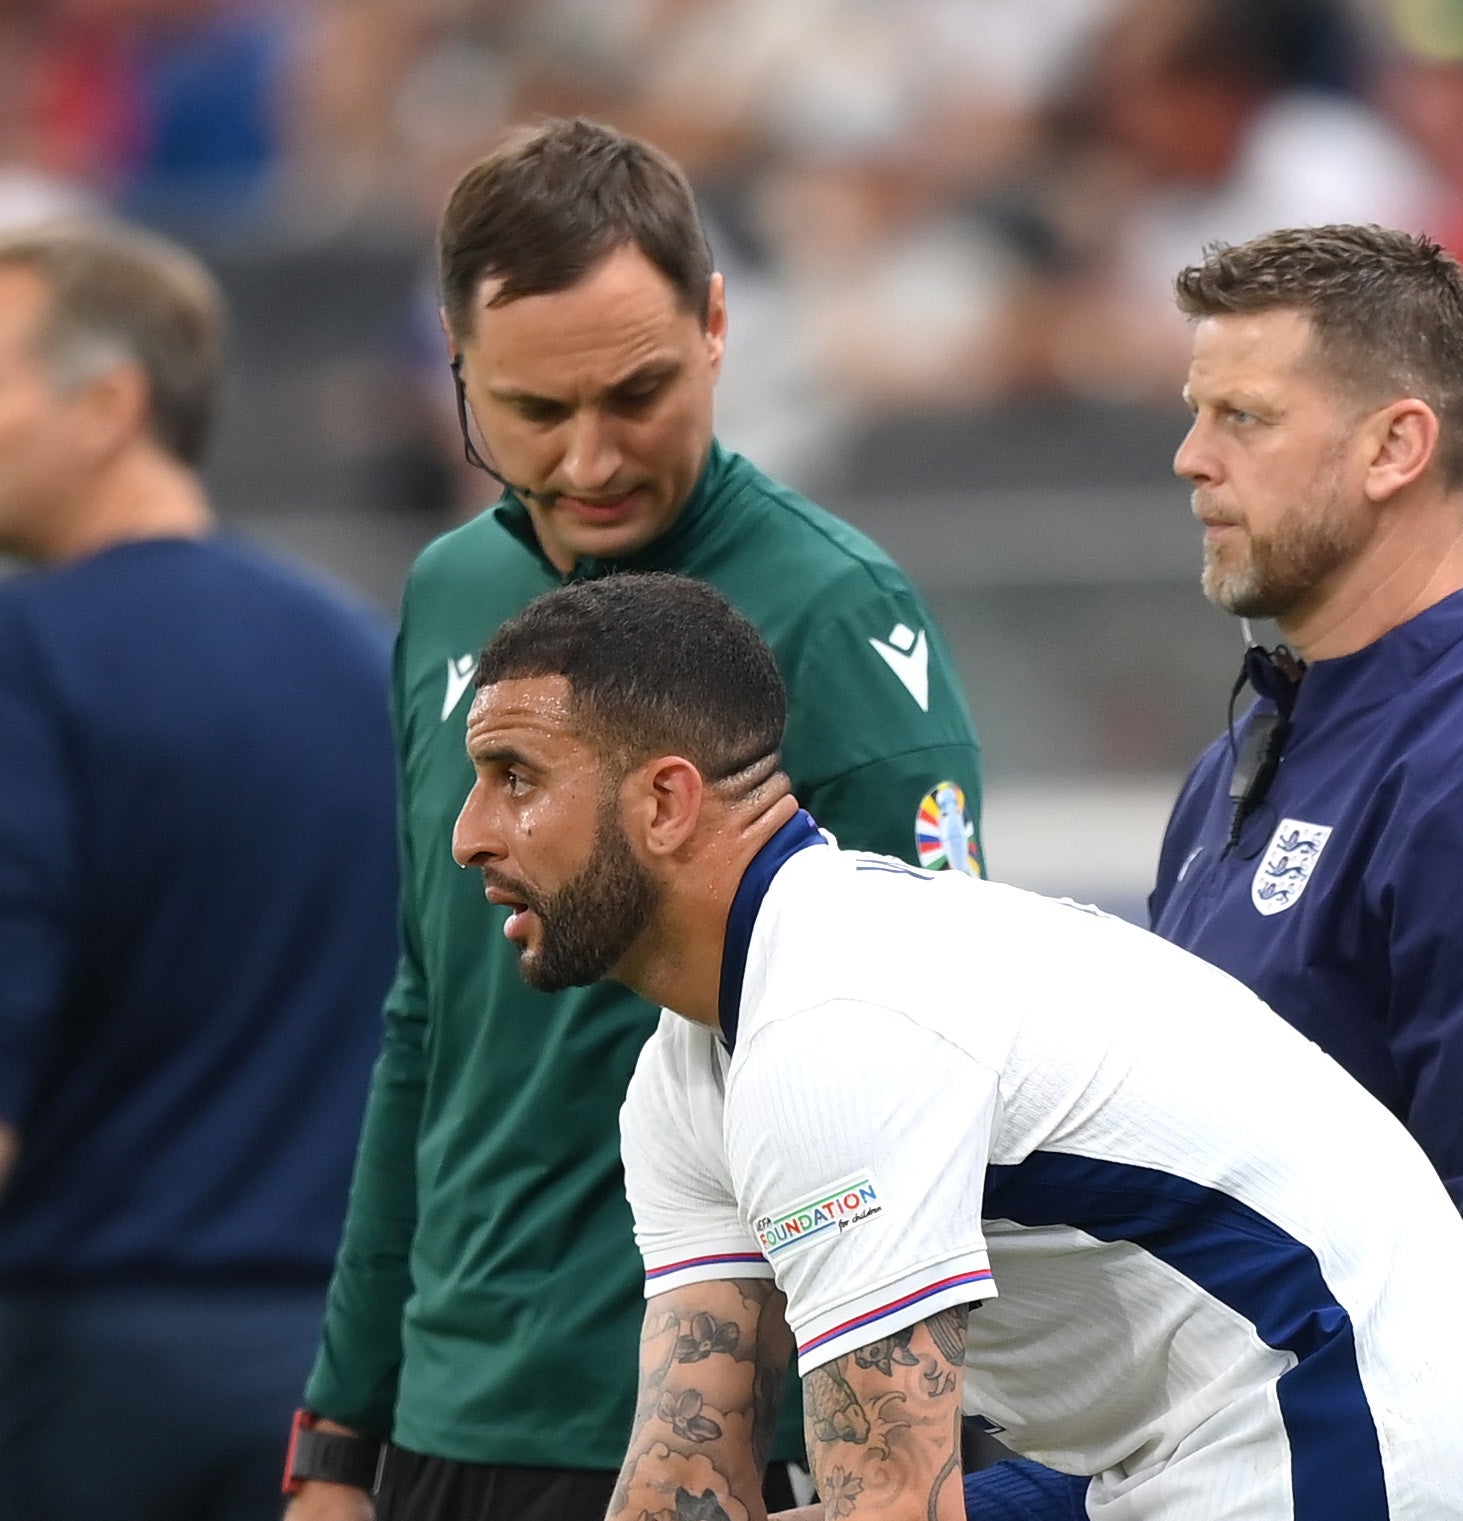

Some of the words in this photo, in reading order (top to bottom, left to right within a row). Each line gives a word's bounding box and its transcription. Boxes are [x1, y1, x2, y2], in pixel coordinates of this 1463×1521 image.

[759, 1185, 877, 1248] FOUNDATION
[838, 1218, 849, 1233] for
[852, 1206, 881, 1223] children
